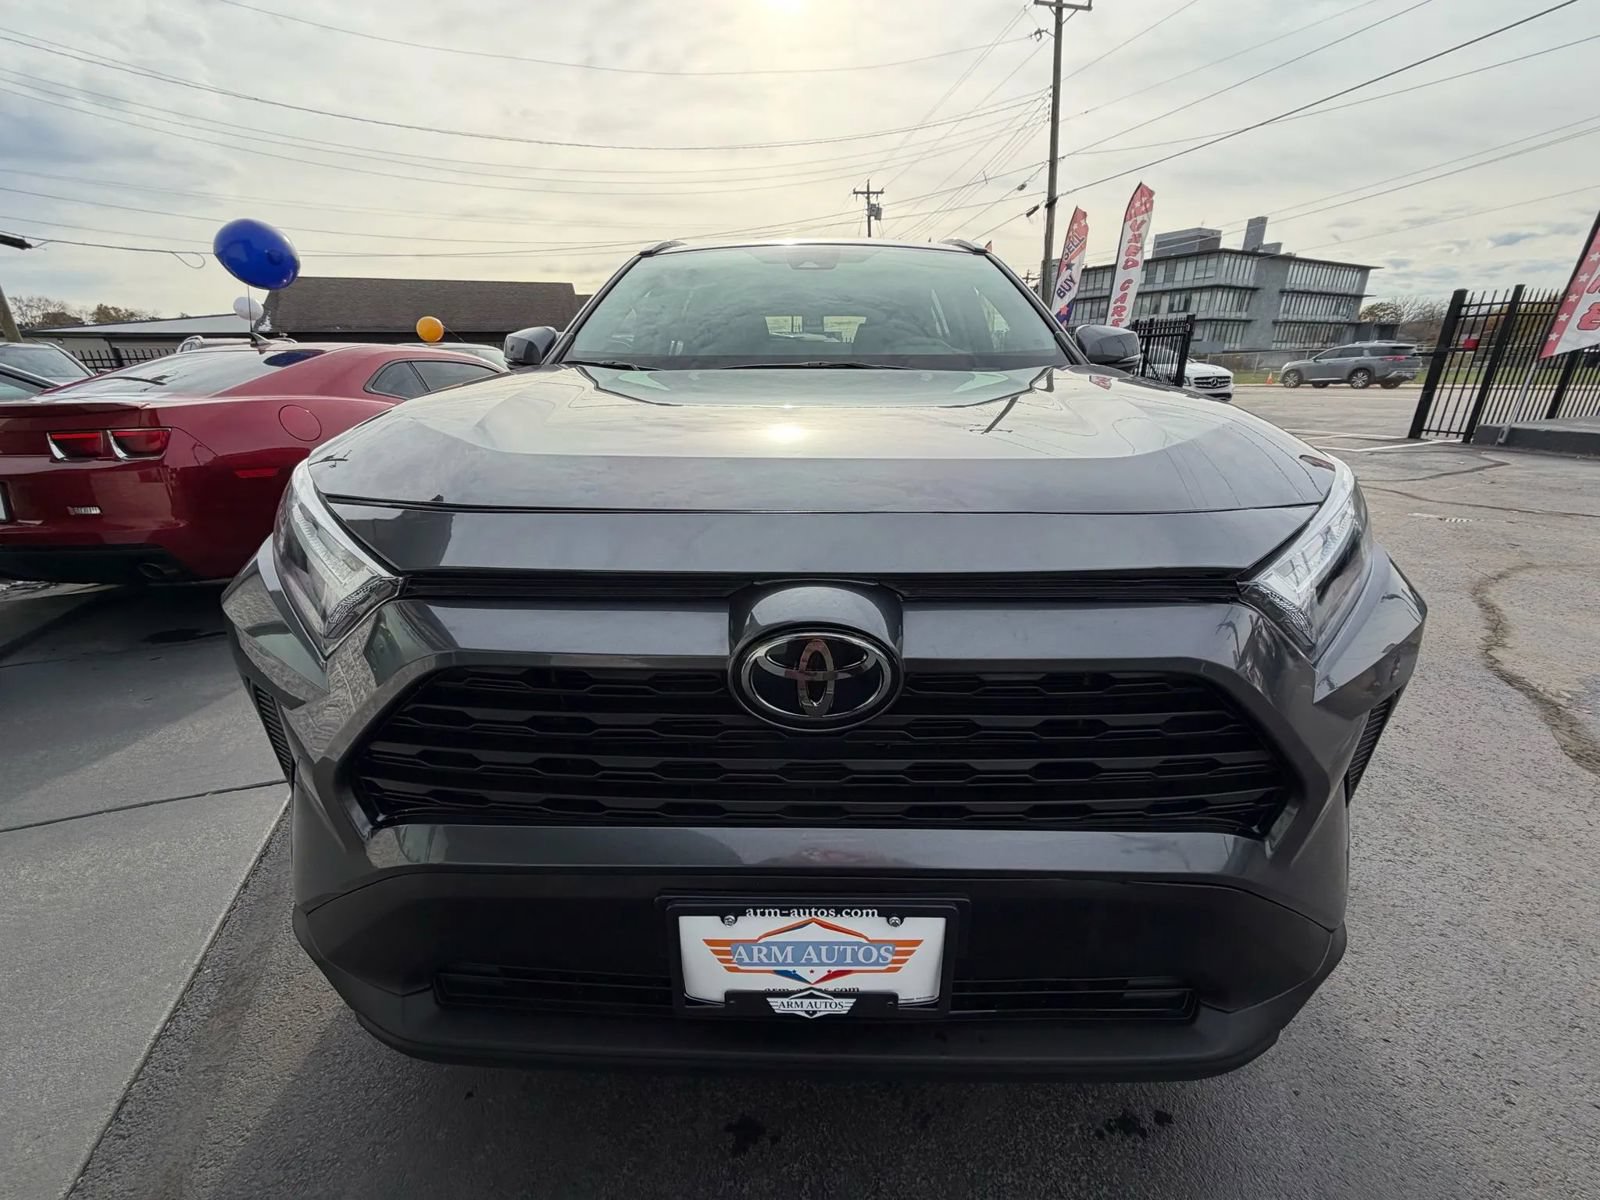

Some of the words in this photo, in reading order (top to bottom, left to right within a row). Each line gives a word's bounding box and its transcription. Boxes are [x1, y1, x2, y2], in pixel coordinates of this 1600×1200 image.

[1063, 232, 1085, 261] SELL
[1056, 274, 1077, 299] BUY
[1110, 278, 1134, 327] CARS
[745, 907, 878, 918] arm-autos.com
[732, 944, 795, 964] ARM
[799, 944, 893, 964] AUTOS
[778, 1000, 804, 1009] ARM
[806, 1000, 844, 1009] AUTOS
